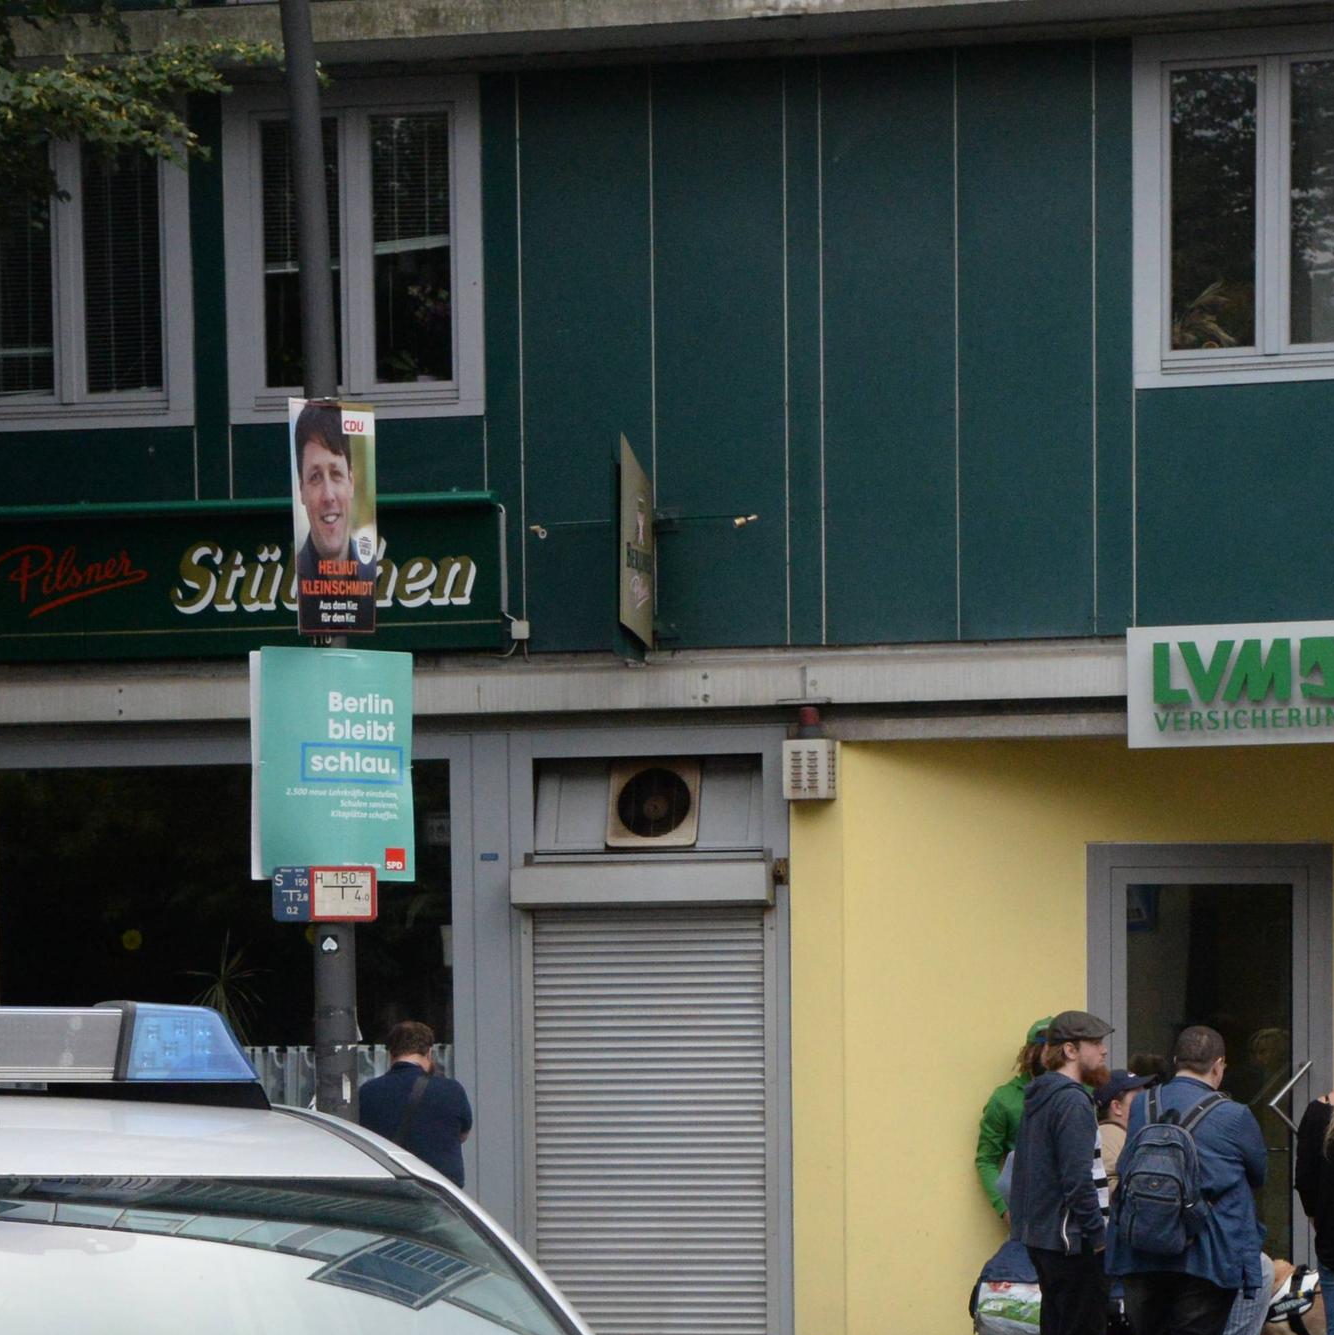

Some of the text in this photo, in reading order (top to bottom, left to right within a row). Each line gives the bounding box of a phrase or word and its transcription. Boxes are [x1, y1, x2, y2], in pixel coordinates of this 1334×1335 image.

[344, 420, 364, 433] CDU
[171, 537, 476, 613] Stühen
[318, 560, 358, 576] HELMUT
[302, 580, 374, 597] KLEINSCHMIDT
[319, 600, 332, 611] Aus
[333, 601, 347, 611] dem
[321, 612, 332, 623] für
[332, 613, 346, 623] den
[1153, 638, 1292, 704] LVM
[328, 691, 394, 715] Berlin
[328, 718, 396, 742] bleibt
[310, 752, 397, 774] schlau.
[386, 861, 403, 870] SPD
[274, 873, 284, 887] S
[295, 878, 308, 887] 150
[315, 872, 357, 885] H 150
